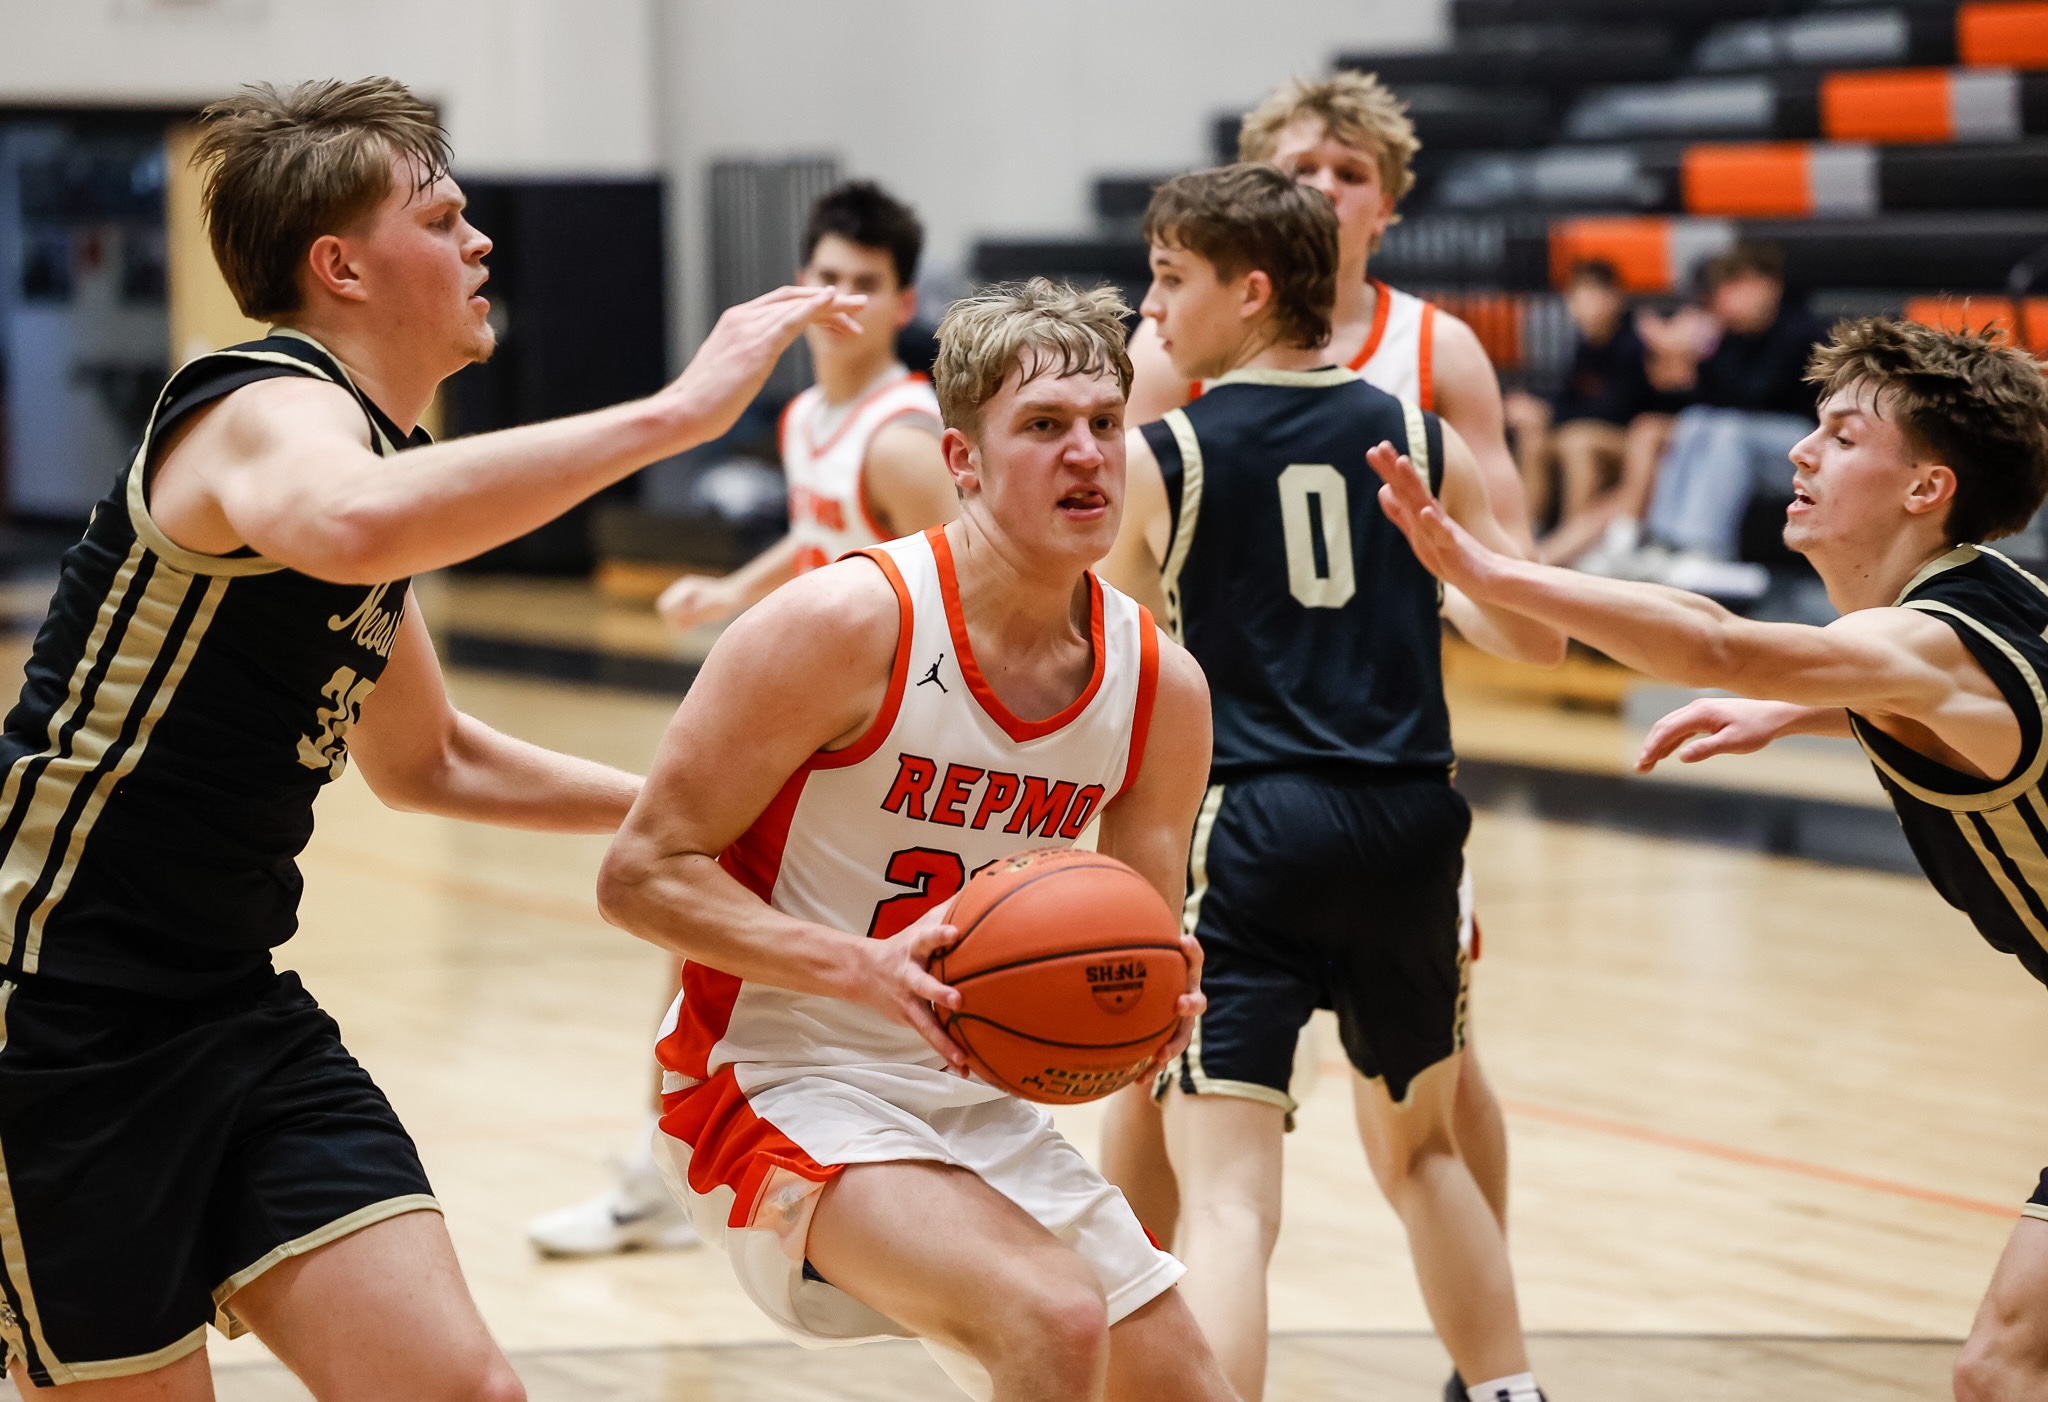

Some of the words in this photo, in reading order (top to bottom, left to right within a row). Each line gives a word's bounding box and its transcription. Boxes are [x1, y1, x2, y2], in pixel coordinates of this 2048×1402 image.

[1277, 464, 1357, 609] 0
[880, 752, 1106, 840] REPMO
[866, 846, 1000, 940] 2
[1086, 963, 1134, 982] NFHS
